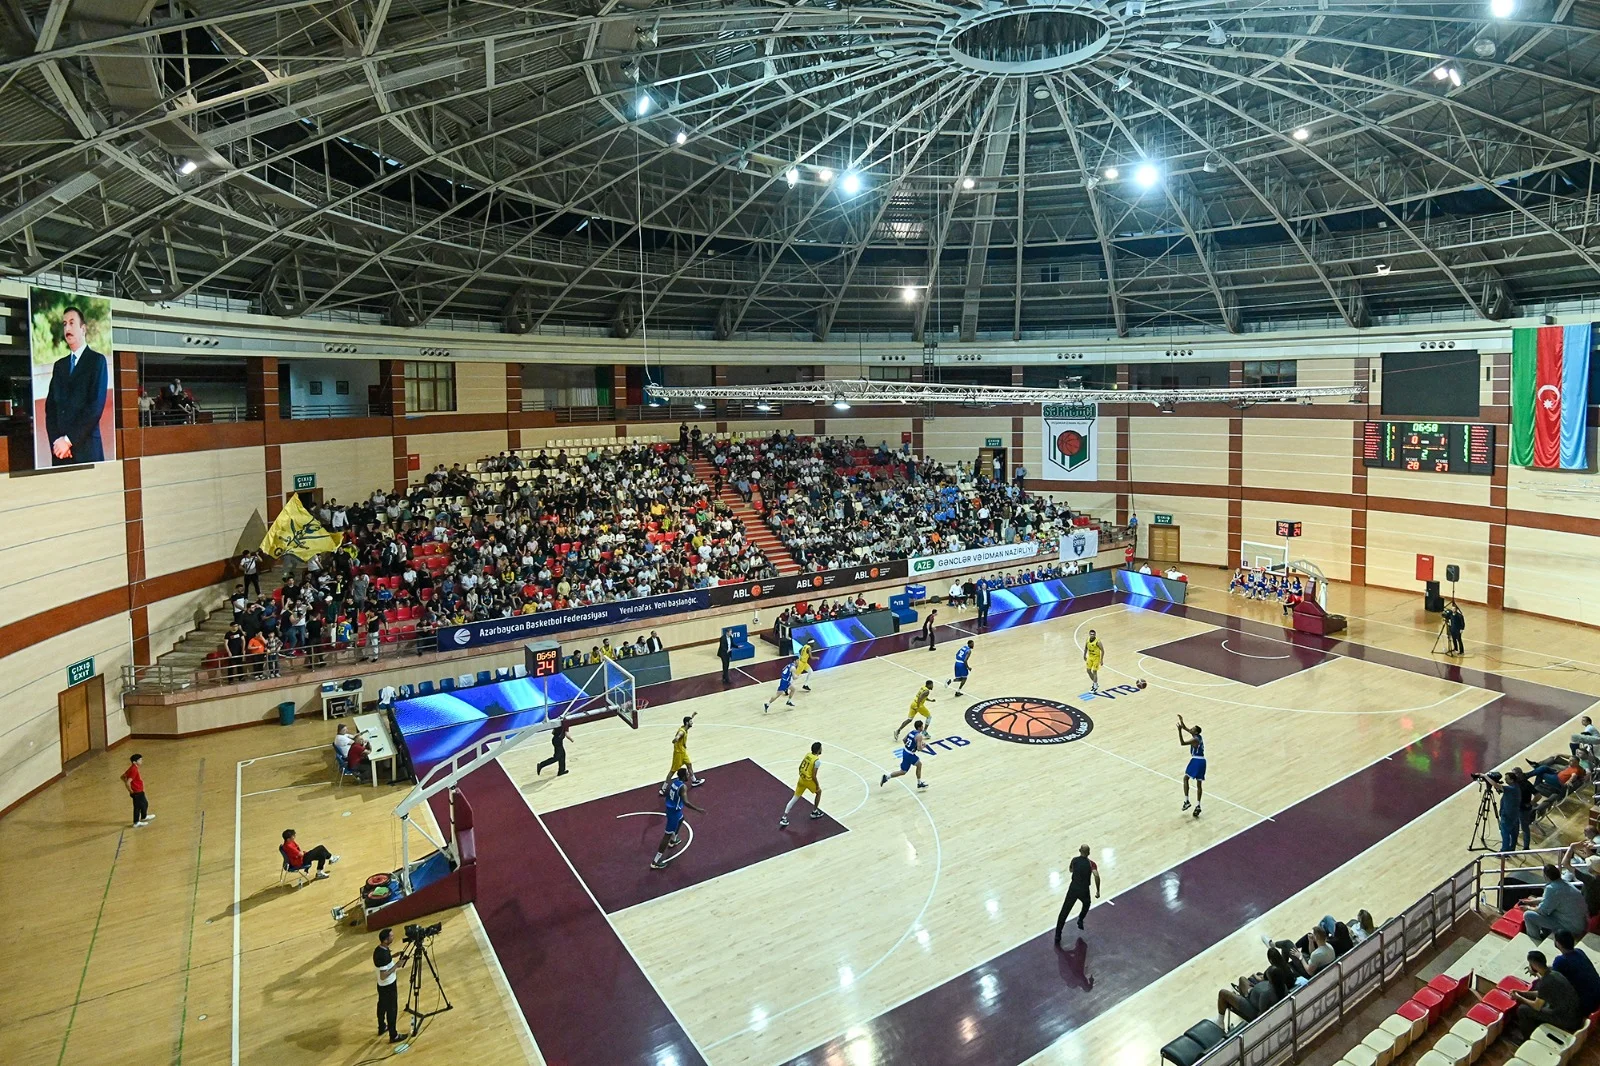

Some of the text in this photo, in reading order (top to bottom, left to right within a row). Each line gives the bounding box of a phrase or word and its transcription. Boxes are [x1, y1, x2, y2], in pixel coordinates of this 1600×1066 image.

[1412, 423, 1438, 432] 06:58
[1407, 461, 1420, 470] 28
[1435, 463, 1448, 472] 27
[917, 560, 931, 570] AZE
[938, 557, 972, 567] GƏNCLƏR
[854, 570, 869, 580] ABL
[796, 579, 812, 589] ABL
[733, 588, 750, 599] ABL
[619, 606, 633, 614] Yeni
[654, 600, 668, 609] Yeni
[479, 610, 608, 637] Azərbaycan Basketbol Federasiyası
[536, 660, 555, 676] 24
[73, 670, 90, 681] EXIT
